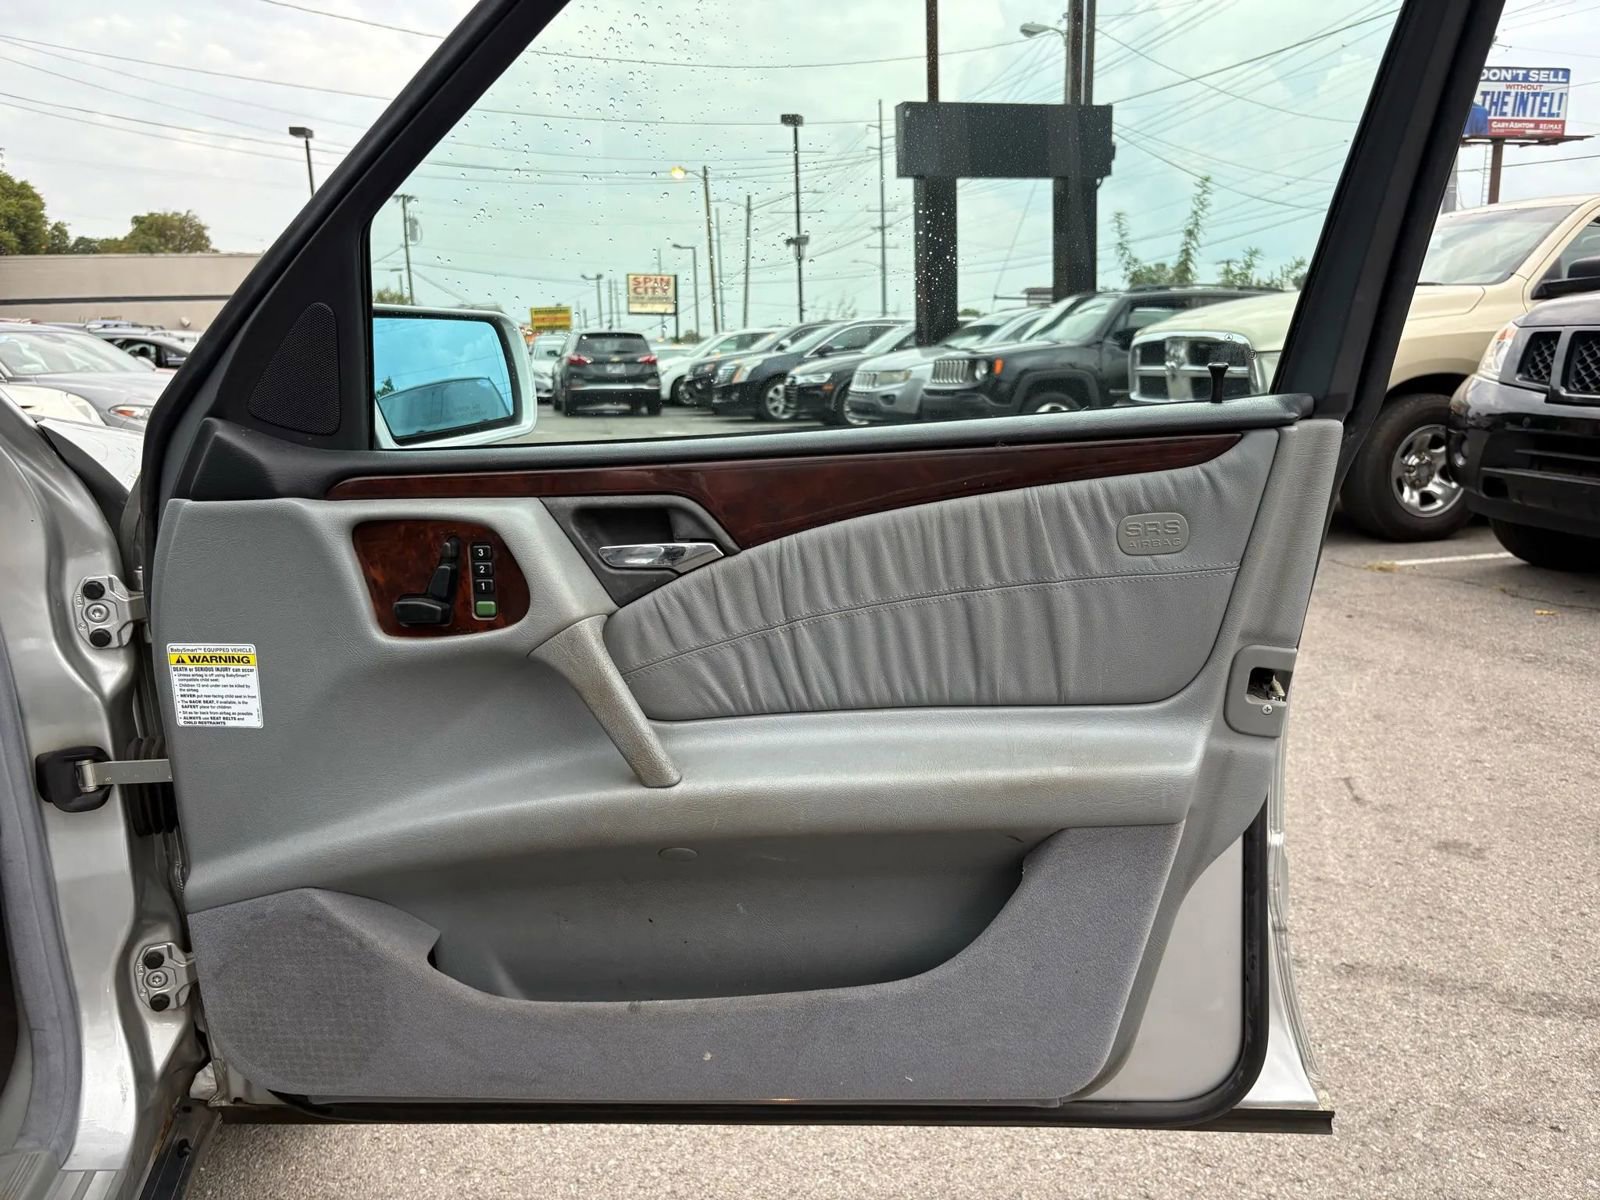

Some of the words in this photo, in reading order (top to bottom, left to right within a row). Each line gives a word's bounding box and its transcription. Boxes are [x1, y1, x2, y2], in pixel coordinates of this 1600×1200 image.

[1480, 69, 1527, 81] DON'T
[1528, 69, 1567, 82] SELL
[1480, 91, 1511, 117] THE
[1511, 91, 1564, 118] INTEL!
[632, 277, 671, 286] SPIN
[633, 286, 669, 295] CITY
[1125, 520, 1180, 537] SRS
[1129, 538, 1182, 549] AIRBAG
[478, 549, 484, 557] 3
[479, 566, 485, 574] 2
[480, 582, 485, 590] 1
[188, 655, 250, 664] WARNING
